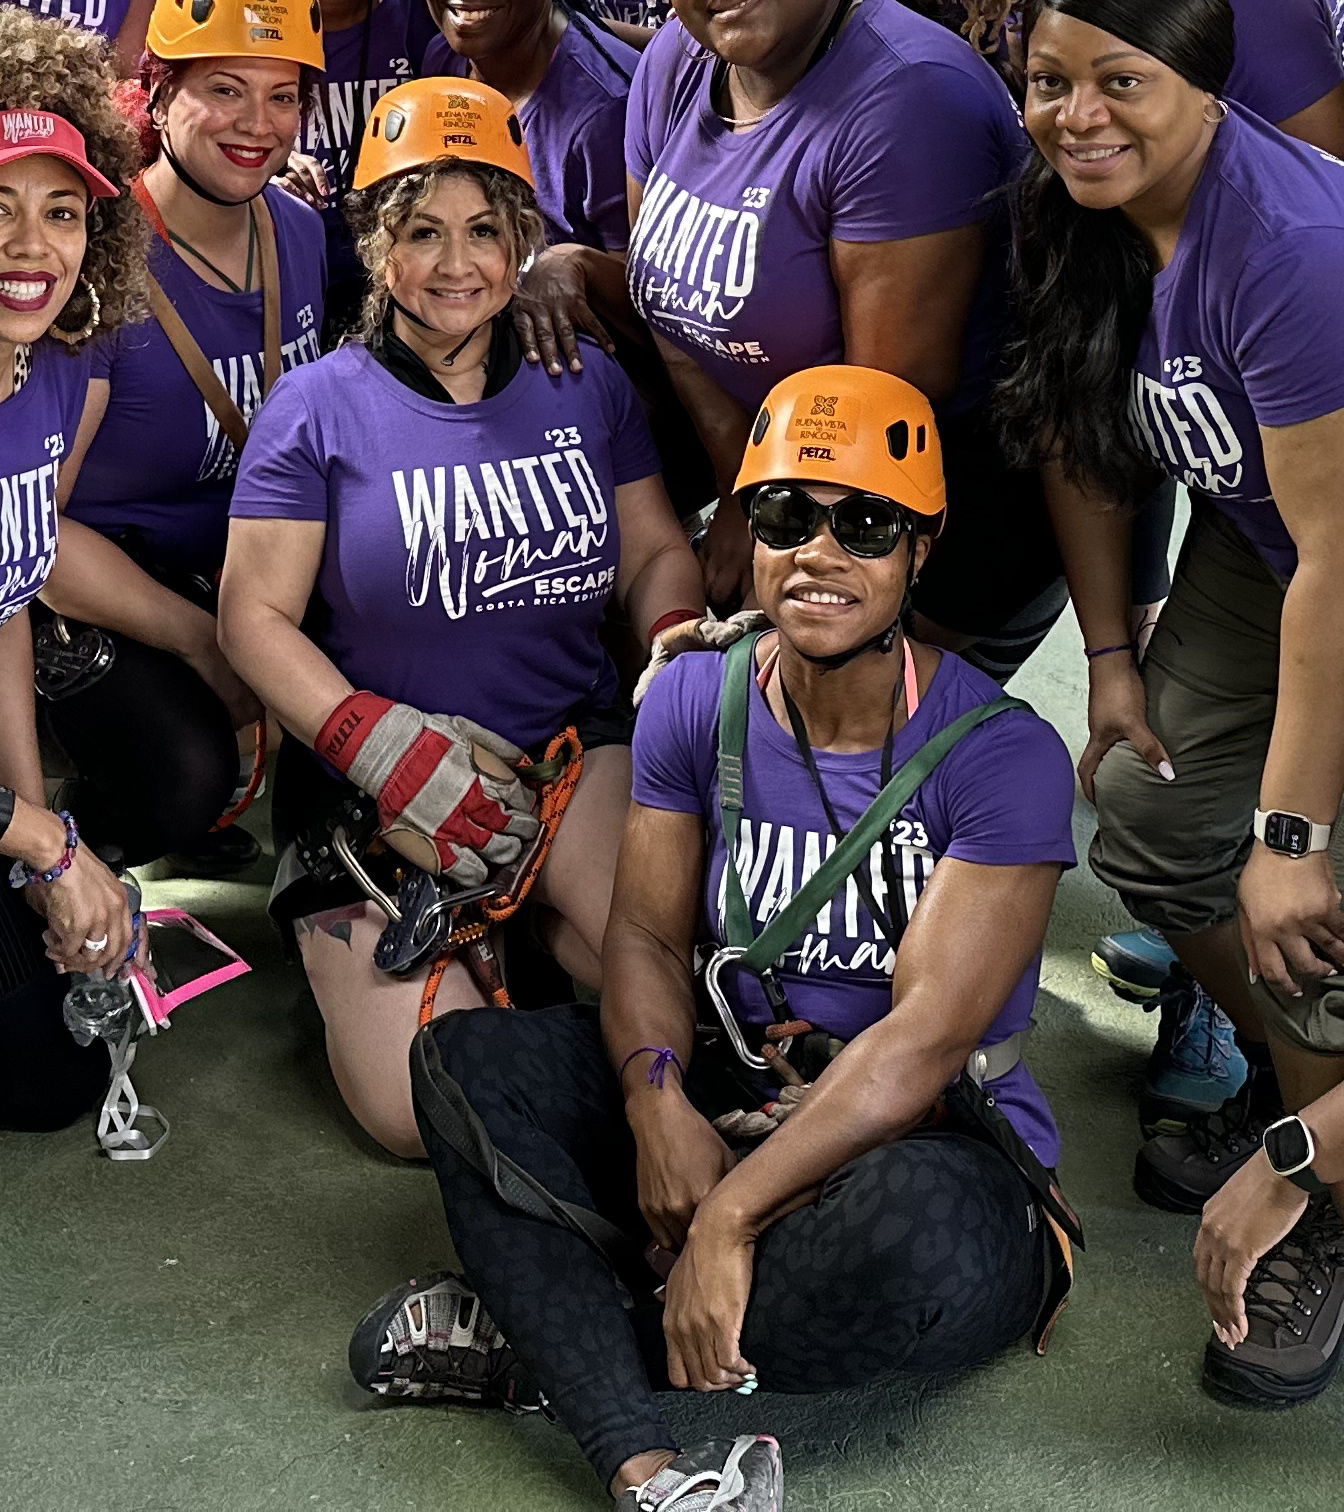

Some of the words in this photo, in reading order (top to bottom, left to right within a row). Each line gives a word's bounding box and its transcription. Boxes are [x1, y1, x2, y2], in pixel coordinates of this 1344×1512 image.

[389, 58, 413, 75] '2
[2, 113, 54, 137] WANTED
[443, 134, 477, 148] PETZL
[631, 164, 759, 298] WANTED
[1164, 355, 1203, 383] '23
[795, 418, 823, 427] BUENA
[824, 420, 847, 431] VISTA
[1127, 368, 1243, 469] NTED
[544, 426, 582, 448] '23
[799, 430, 837, 441] RINCON
[798, 447, 836, 463] PETZL
[392, 449, 608, 549] WANTED
[406, 507, 608, 620] Woman
[535, 565, 616, 596] ESCAPE
[475, 598, 525, 612] COSTA
[533, 596, 567, 606] RICA
